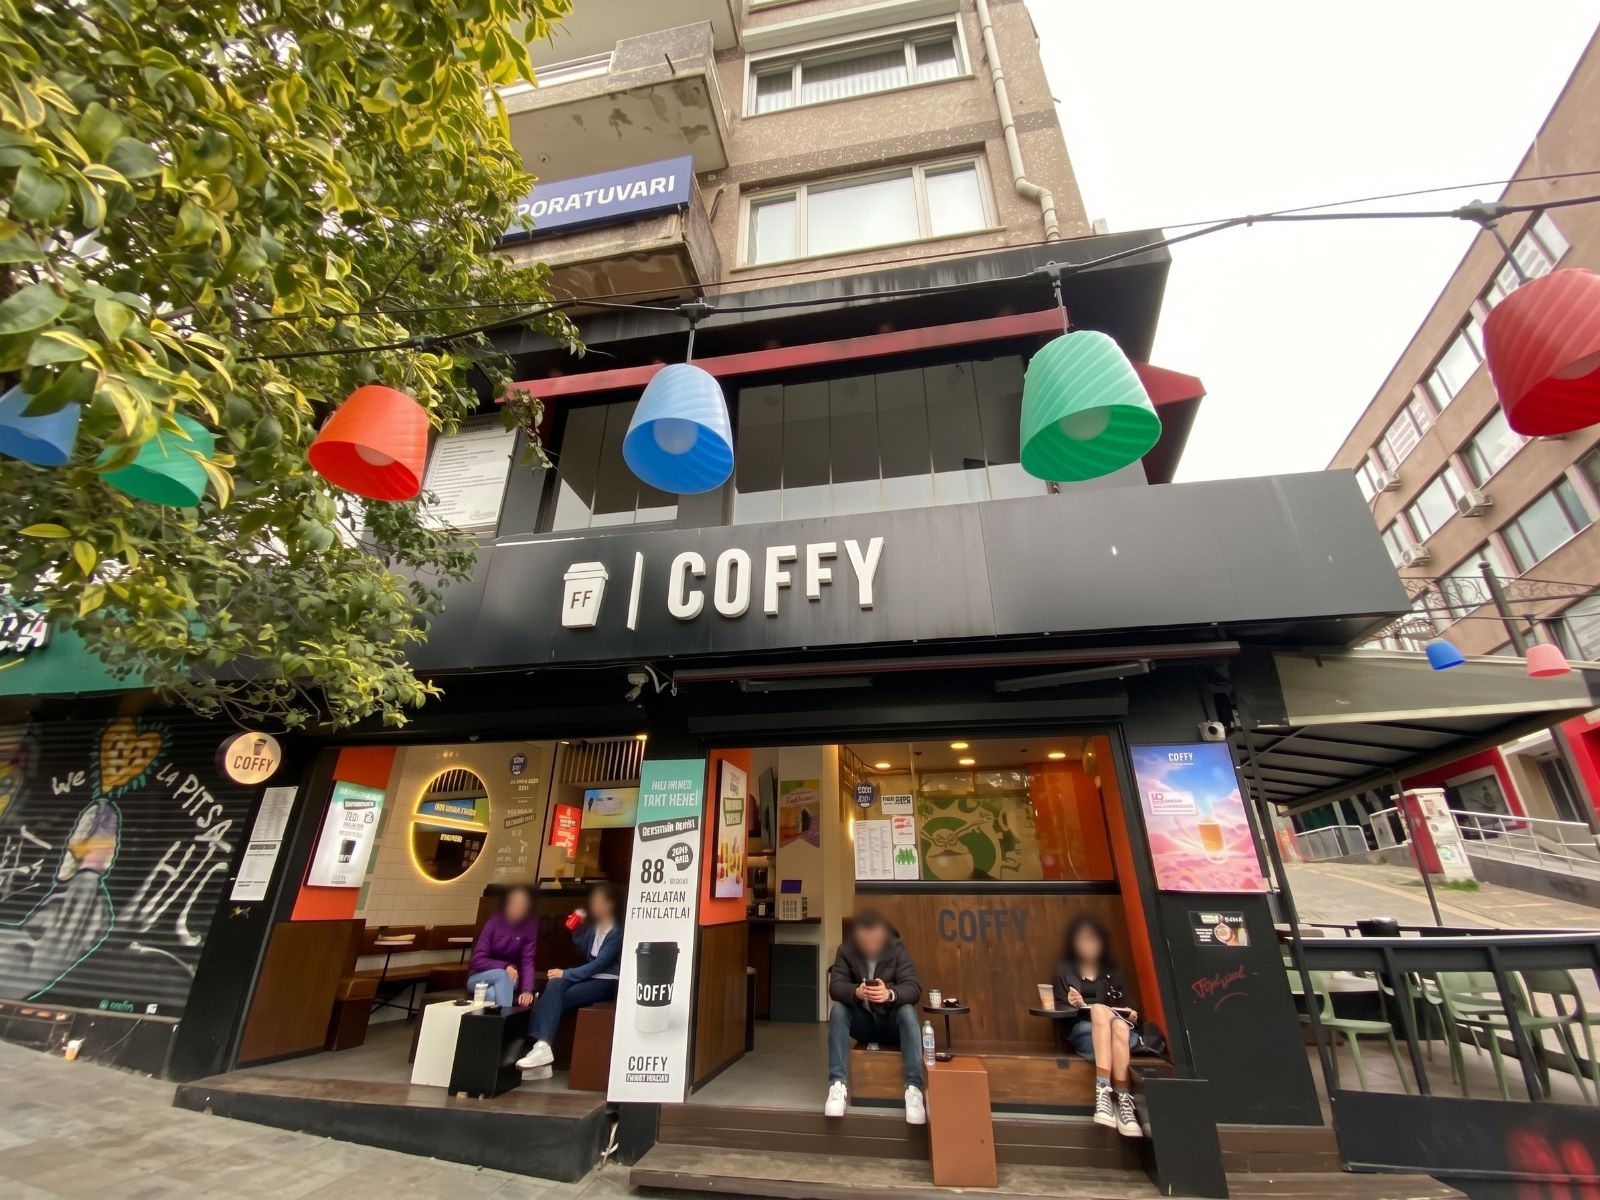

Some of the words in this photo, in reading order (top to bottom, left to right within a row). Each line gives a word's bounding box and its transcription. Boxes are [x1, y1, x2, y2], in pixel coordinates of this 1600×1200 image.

[570, 590, 593, 609] FF
[667, 537, 884, 620] COFFY
[233, 755, 274, 773] COFFY
[1168, 752, 1193, 761] COFFY
[939, 907, 1029, 943] COFFY
[636, 982, 674, 1002] COFFY
[628, 1056, 668, 1071] COFFY
